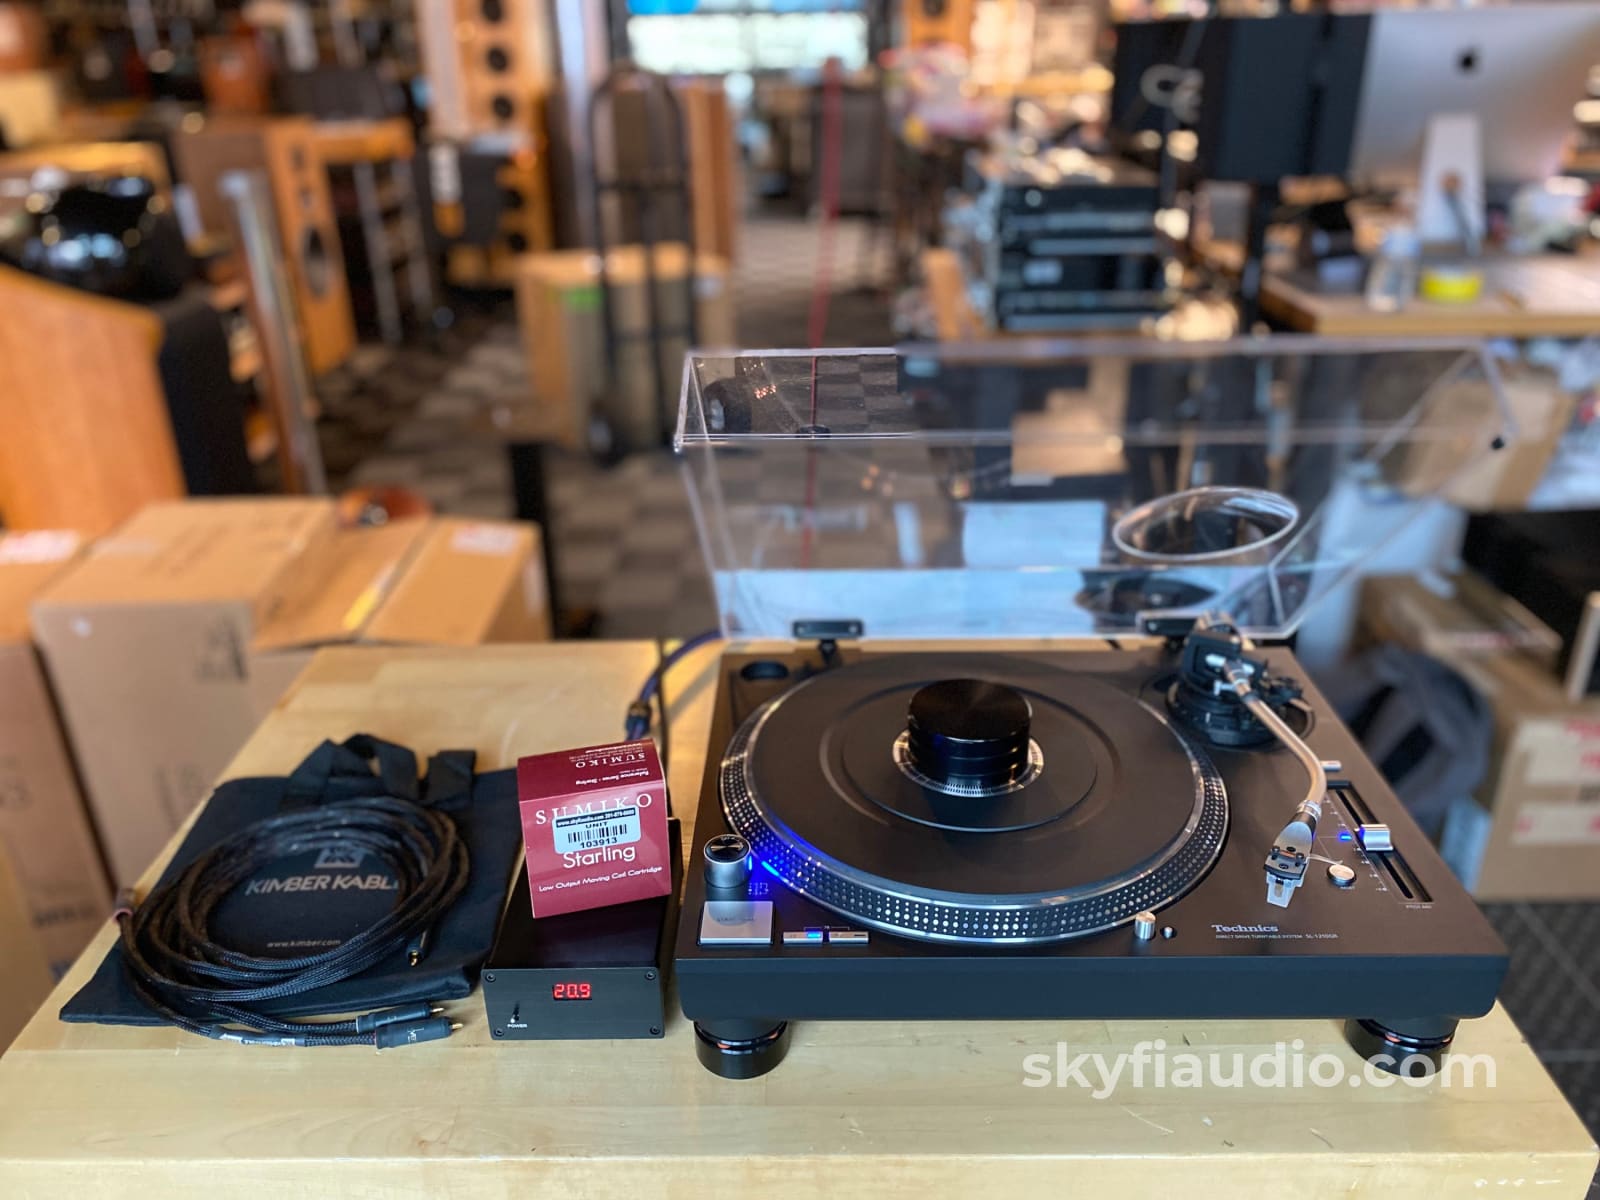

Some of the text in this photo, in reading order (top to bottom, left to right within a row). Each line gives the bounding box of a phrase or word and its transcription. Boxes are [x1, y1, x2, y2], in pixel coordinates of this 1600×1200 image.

[575, 752, 646, 768] SUMIKO
[585, 821, 609, 829] UNIT
[580, 837, 618, 849] 103913
[563, 846, 636, 868] Starling
[245, 875, 331, 896] KIMBER
[555, 880, 581, 889] Output
[582, 875, 610, 884] Moving
[611, 871, 627, 879] Coil
[628, 866, 663, 877] Cartridge
[1211, 924, 1279, 933] Technics
[267, 939, 342, 948] www.kimber.com
[553, 983, 591, 999] 20.9
